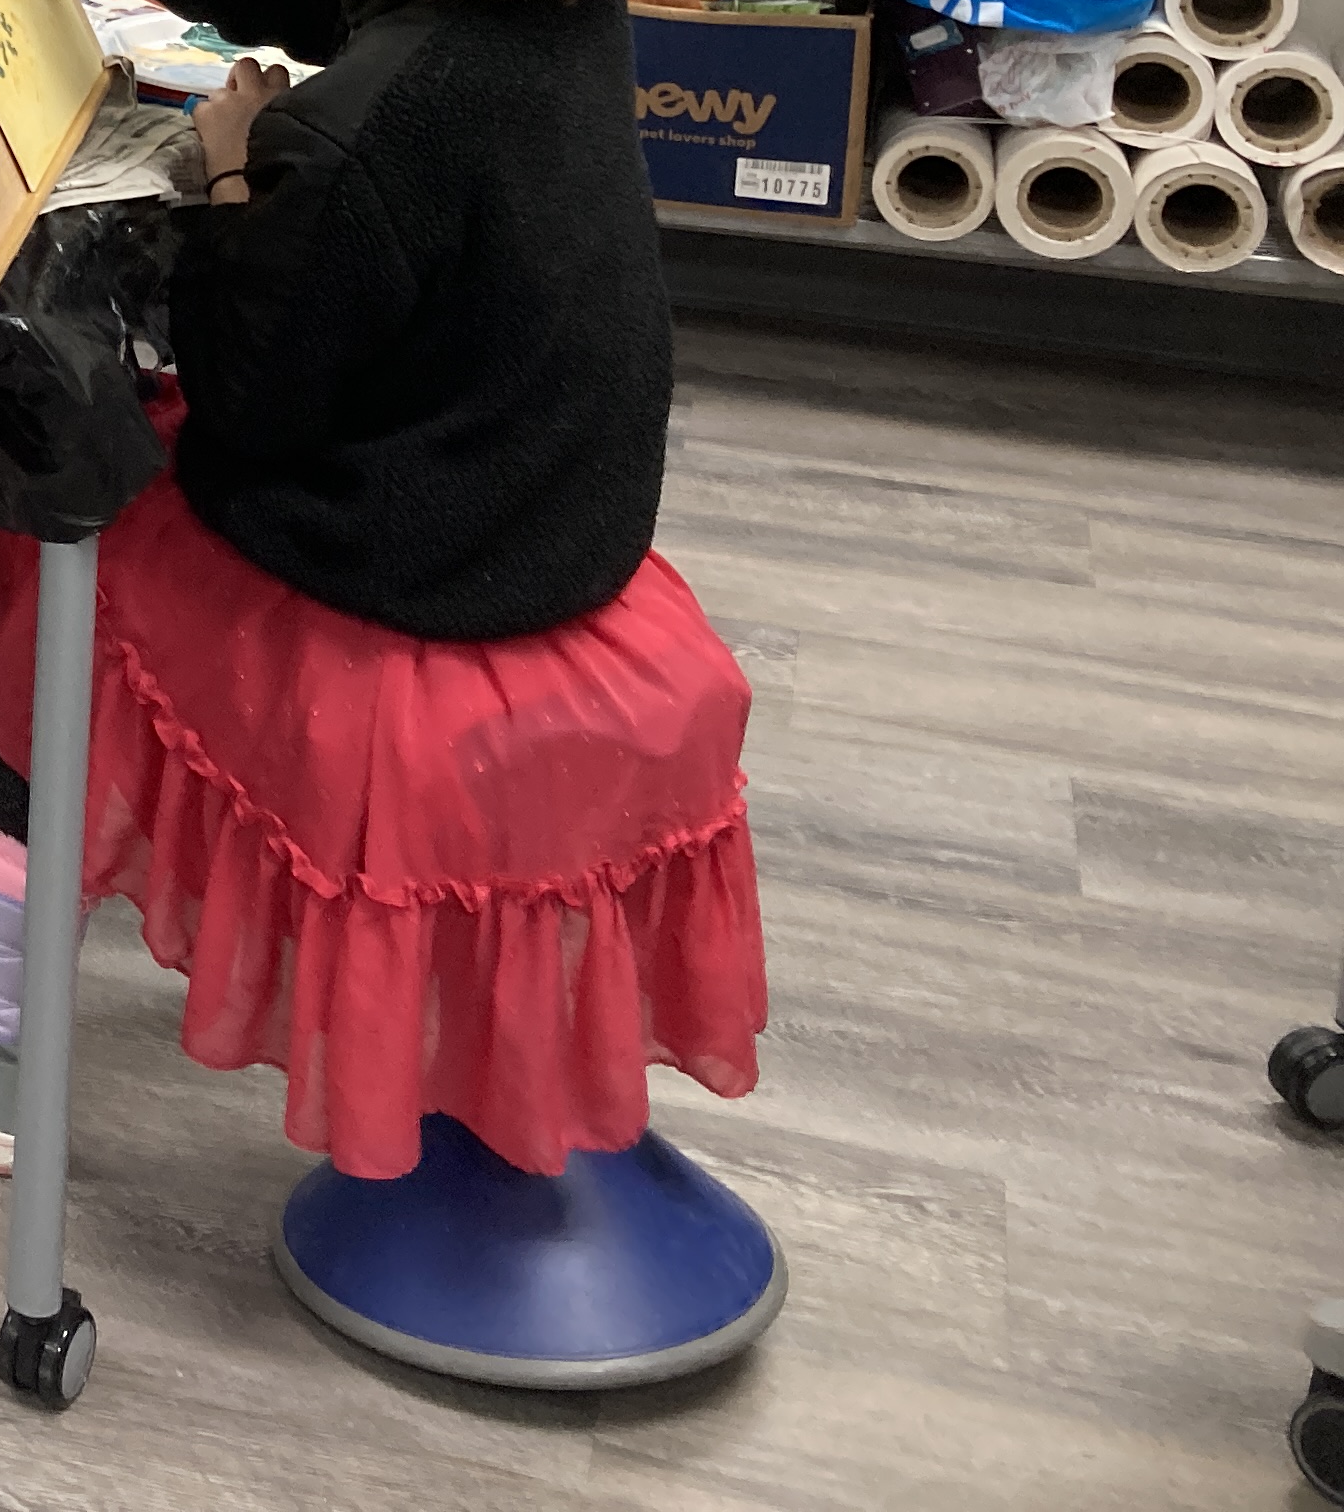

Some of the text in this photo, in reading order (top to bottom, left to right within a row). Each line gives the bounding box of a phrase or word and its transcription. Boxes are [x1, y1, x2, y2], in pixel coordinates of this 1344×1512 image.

[640, 128, 757, 150] pet lovers shop
[762, 178, 822, 198] 10775
